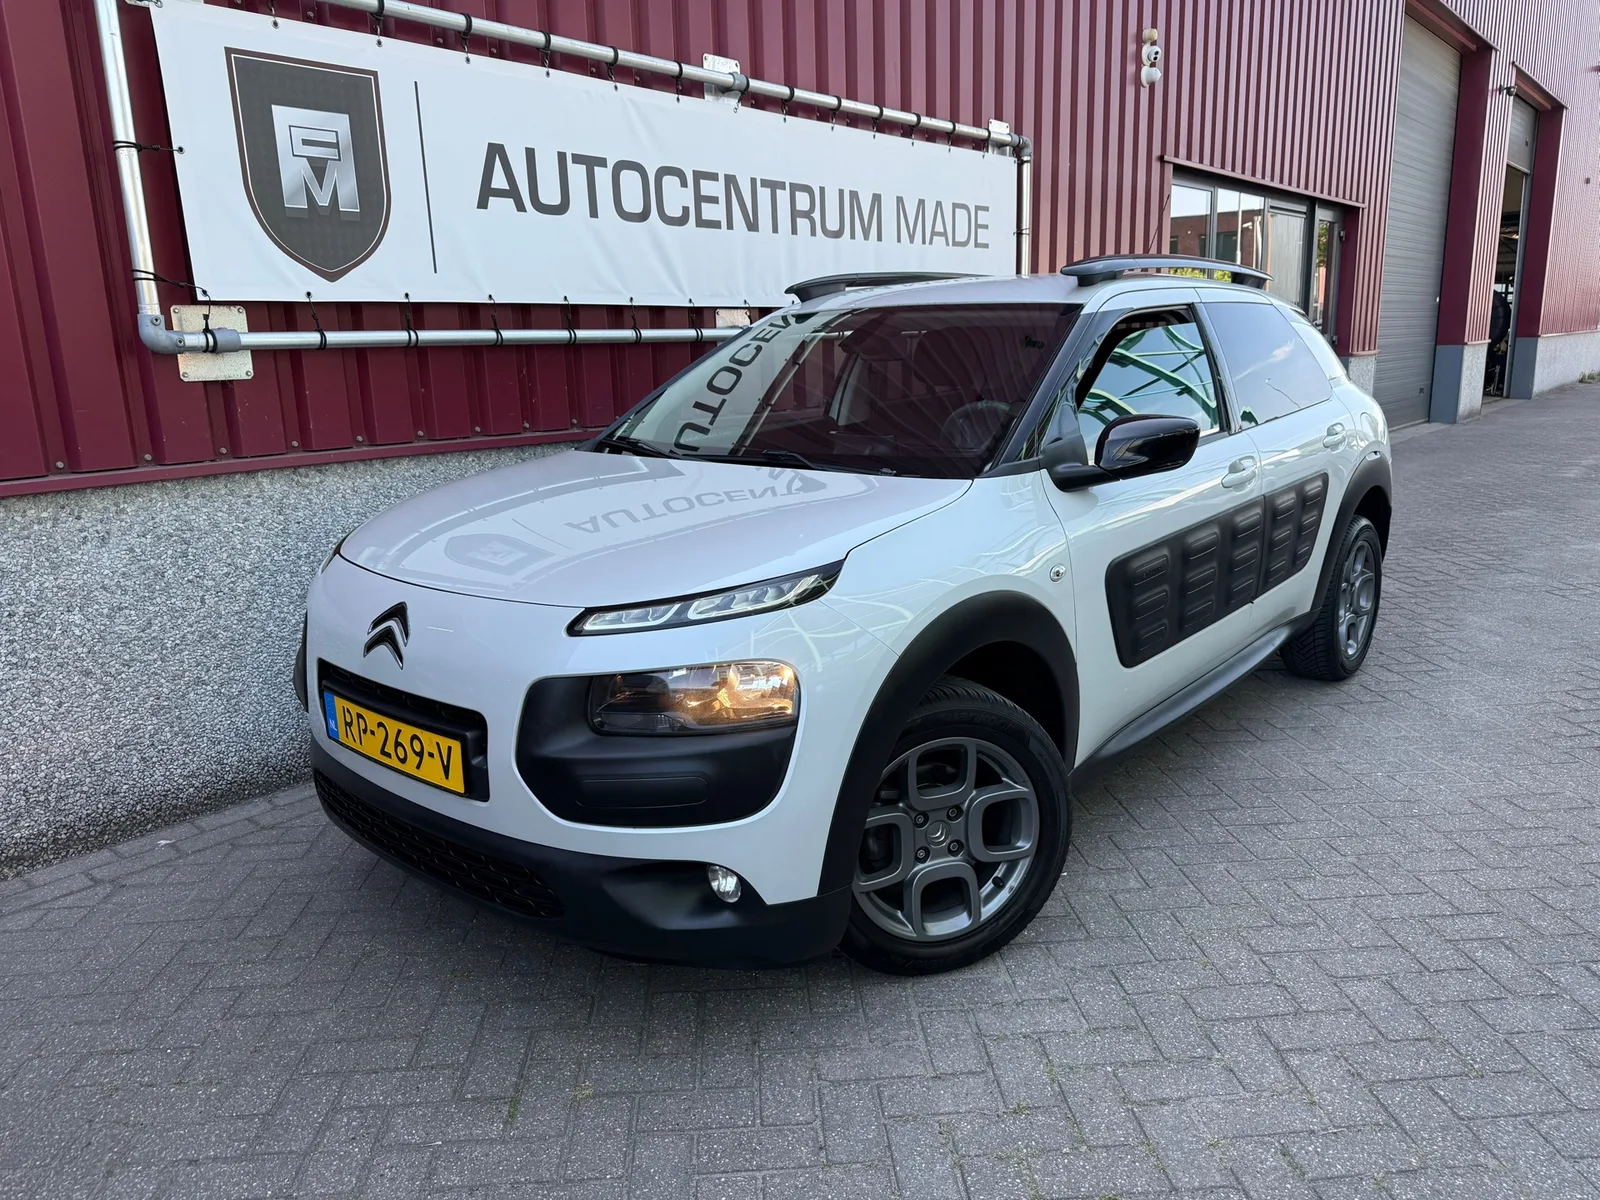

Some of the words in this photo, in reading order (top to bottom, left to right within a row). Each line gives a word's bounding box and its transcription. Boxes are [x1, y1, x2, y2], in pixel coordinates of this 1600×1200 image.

[476, 142, 883, 243] AUTOCENTRUM
[896, 195, 990, 249] MADE
[329, 718, 338, 732] NL
[342, 705, 453, 781] RP-269-V
